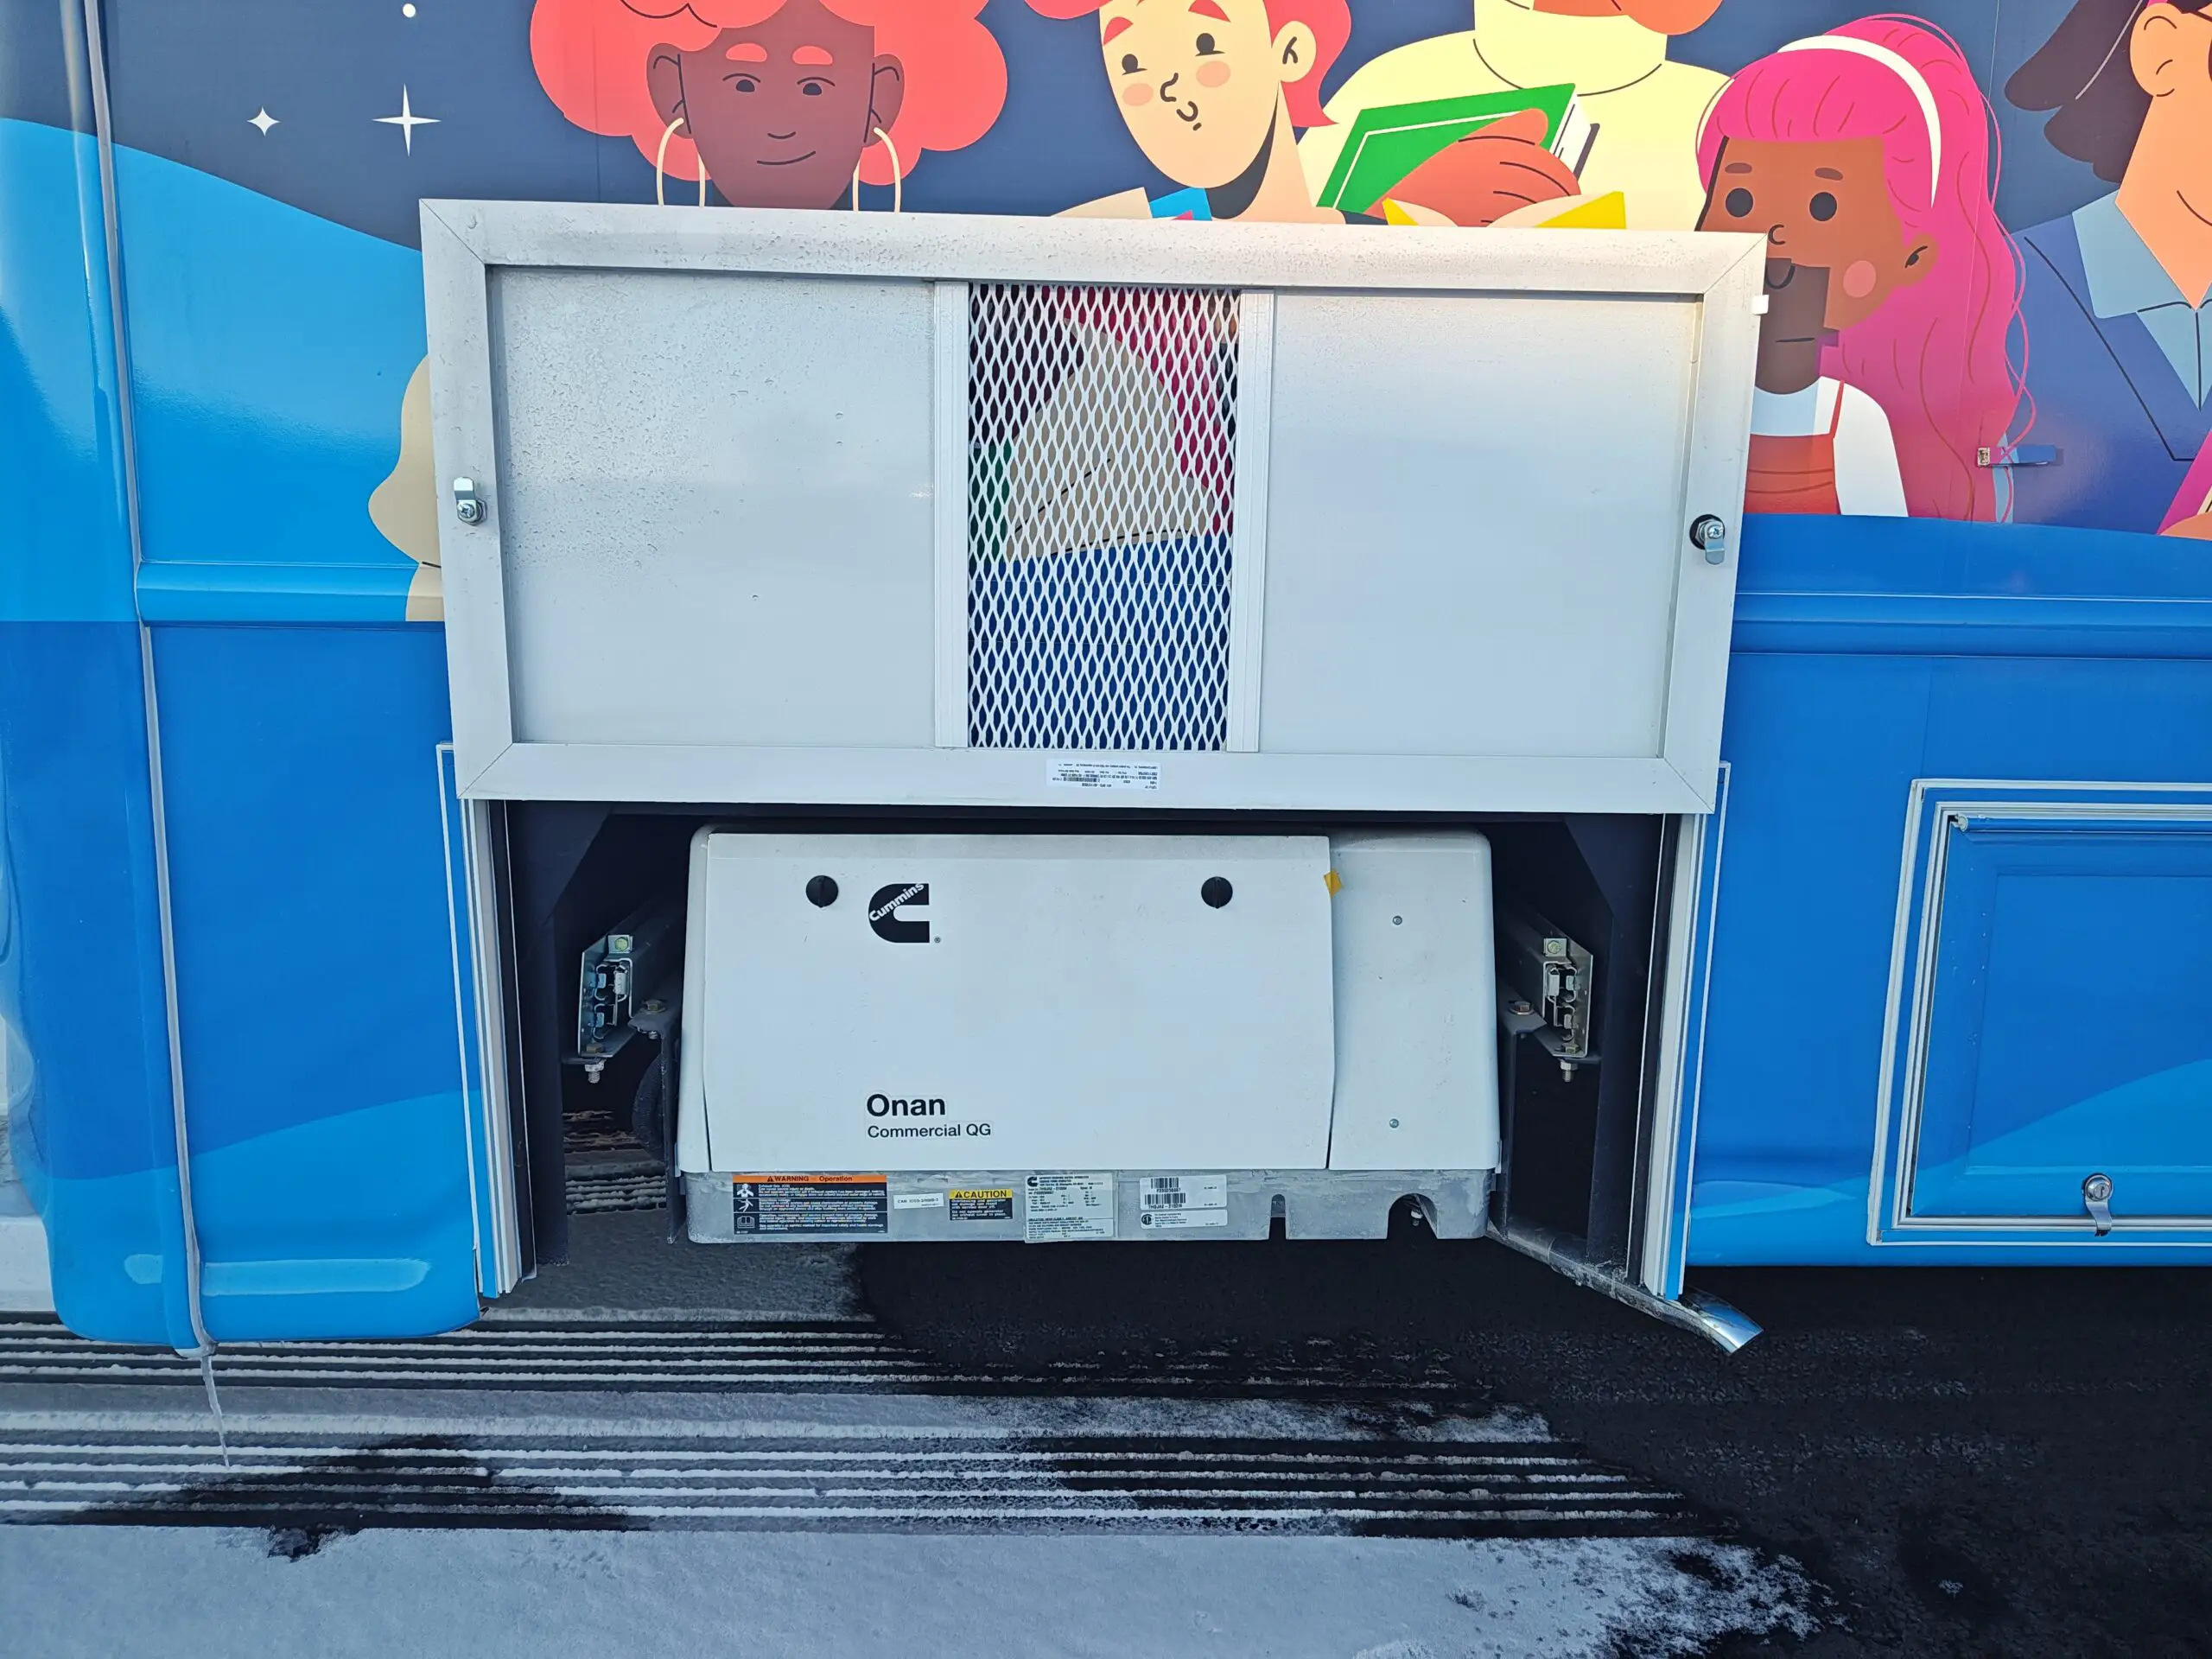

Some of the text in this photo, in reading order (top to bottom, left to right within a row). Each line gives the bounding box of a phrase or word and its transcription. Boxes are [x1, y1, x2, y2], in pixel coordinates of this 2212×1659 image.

[868, 883, 925, 921] Cummins
[867, 1093, 945, 1116] Onan
[868, 1123, 991, 1138] Commercial QG
[963, 1190, 1007, 1198] CAUTION
